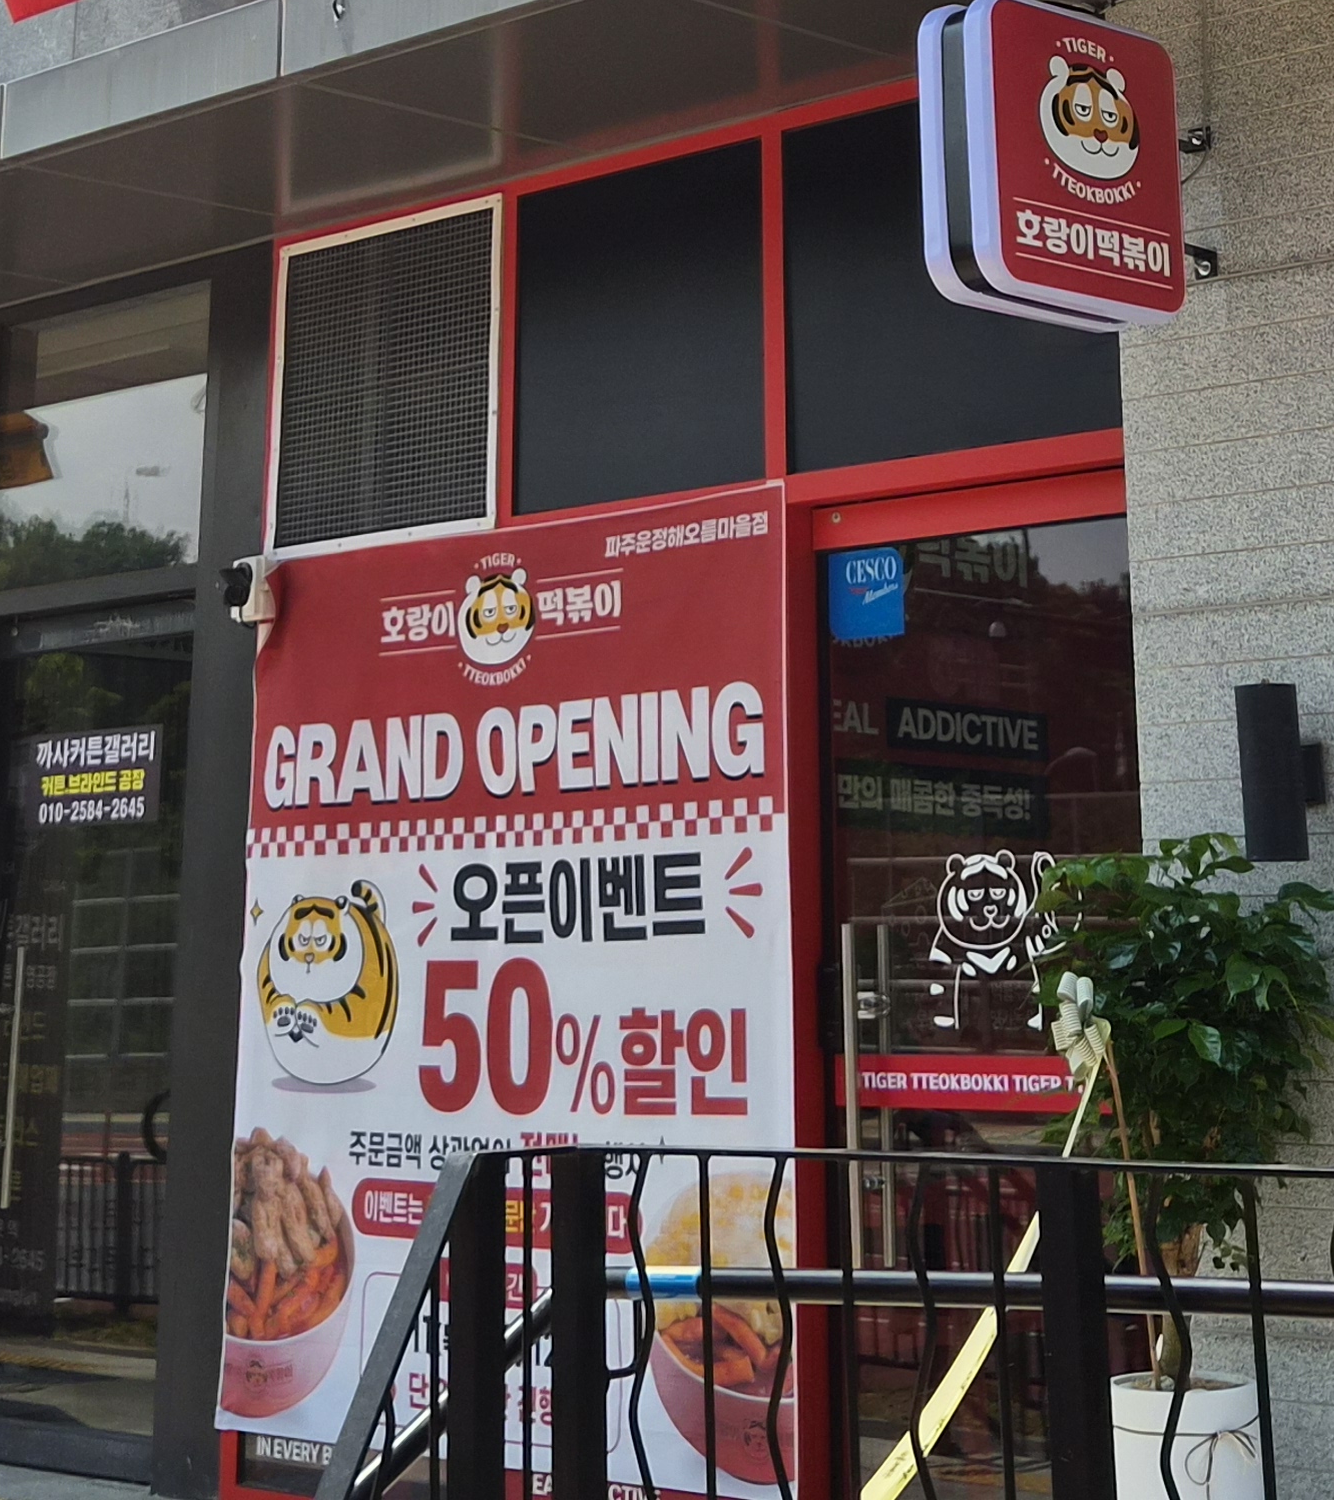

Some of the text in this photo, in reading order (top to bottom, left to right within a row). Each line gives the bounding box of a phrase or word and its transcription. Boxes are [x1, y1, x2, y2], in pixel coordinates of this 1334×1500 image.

[1063, 37, 1107, 63] TIGER
[1051, 165, 1137, 205] TTEOKBOKKI
[1016, 208, 1171, 277] 호랑이떡볶이
[604, 510, 768, 559] 파주운정해오름마을점
[480, 552, 516, 569] TIGER
[845, 555, 897, 585] CESCO
[380, 580, 623, 645] 호랑이 떡볶이
[463, 656, 528, 687] TTEOKBOKKI
[264, 680, 765, 810] GRAND OPENING
[896, 706, 1039, 751] ADDICTIVE
[36, 730, 155, 769] 까사커튼갤러리
[119, 768, 145, 791] 공장
[39, 796, 145, 824] 010-2584-2645
[889, 777, 956, 817] 매콤한
[960, 782, 1031, 821] 중독성!
[450, 852, 705, 944] 오픈이벤트
[419, 957, 748, 1117] 50%할인
[861, 1071, 908, 1090] TIGER
[910, 1072, 1009, 1092] TTEOKBOKKI
[349, 1131, 422, 1169] 주문금액
[365, 1189, 423, 1226] 이벤트는
[256, 1436, 271, 1456] IN
[273, 1438, 320, 1463] EVERY
